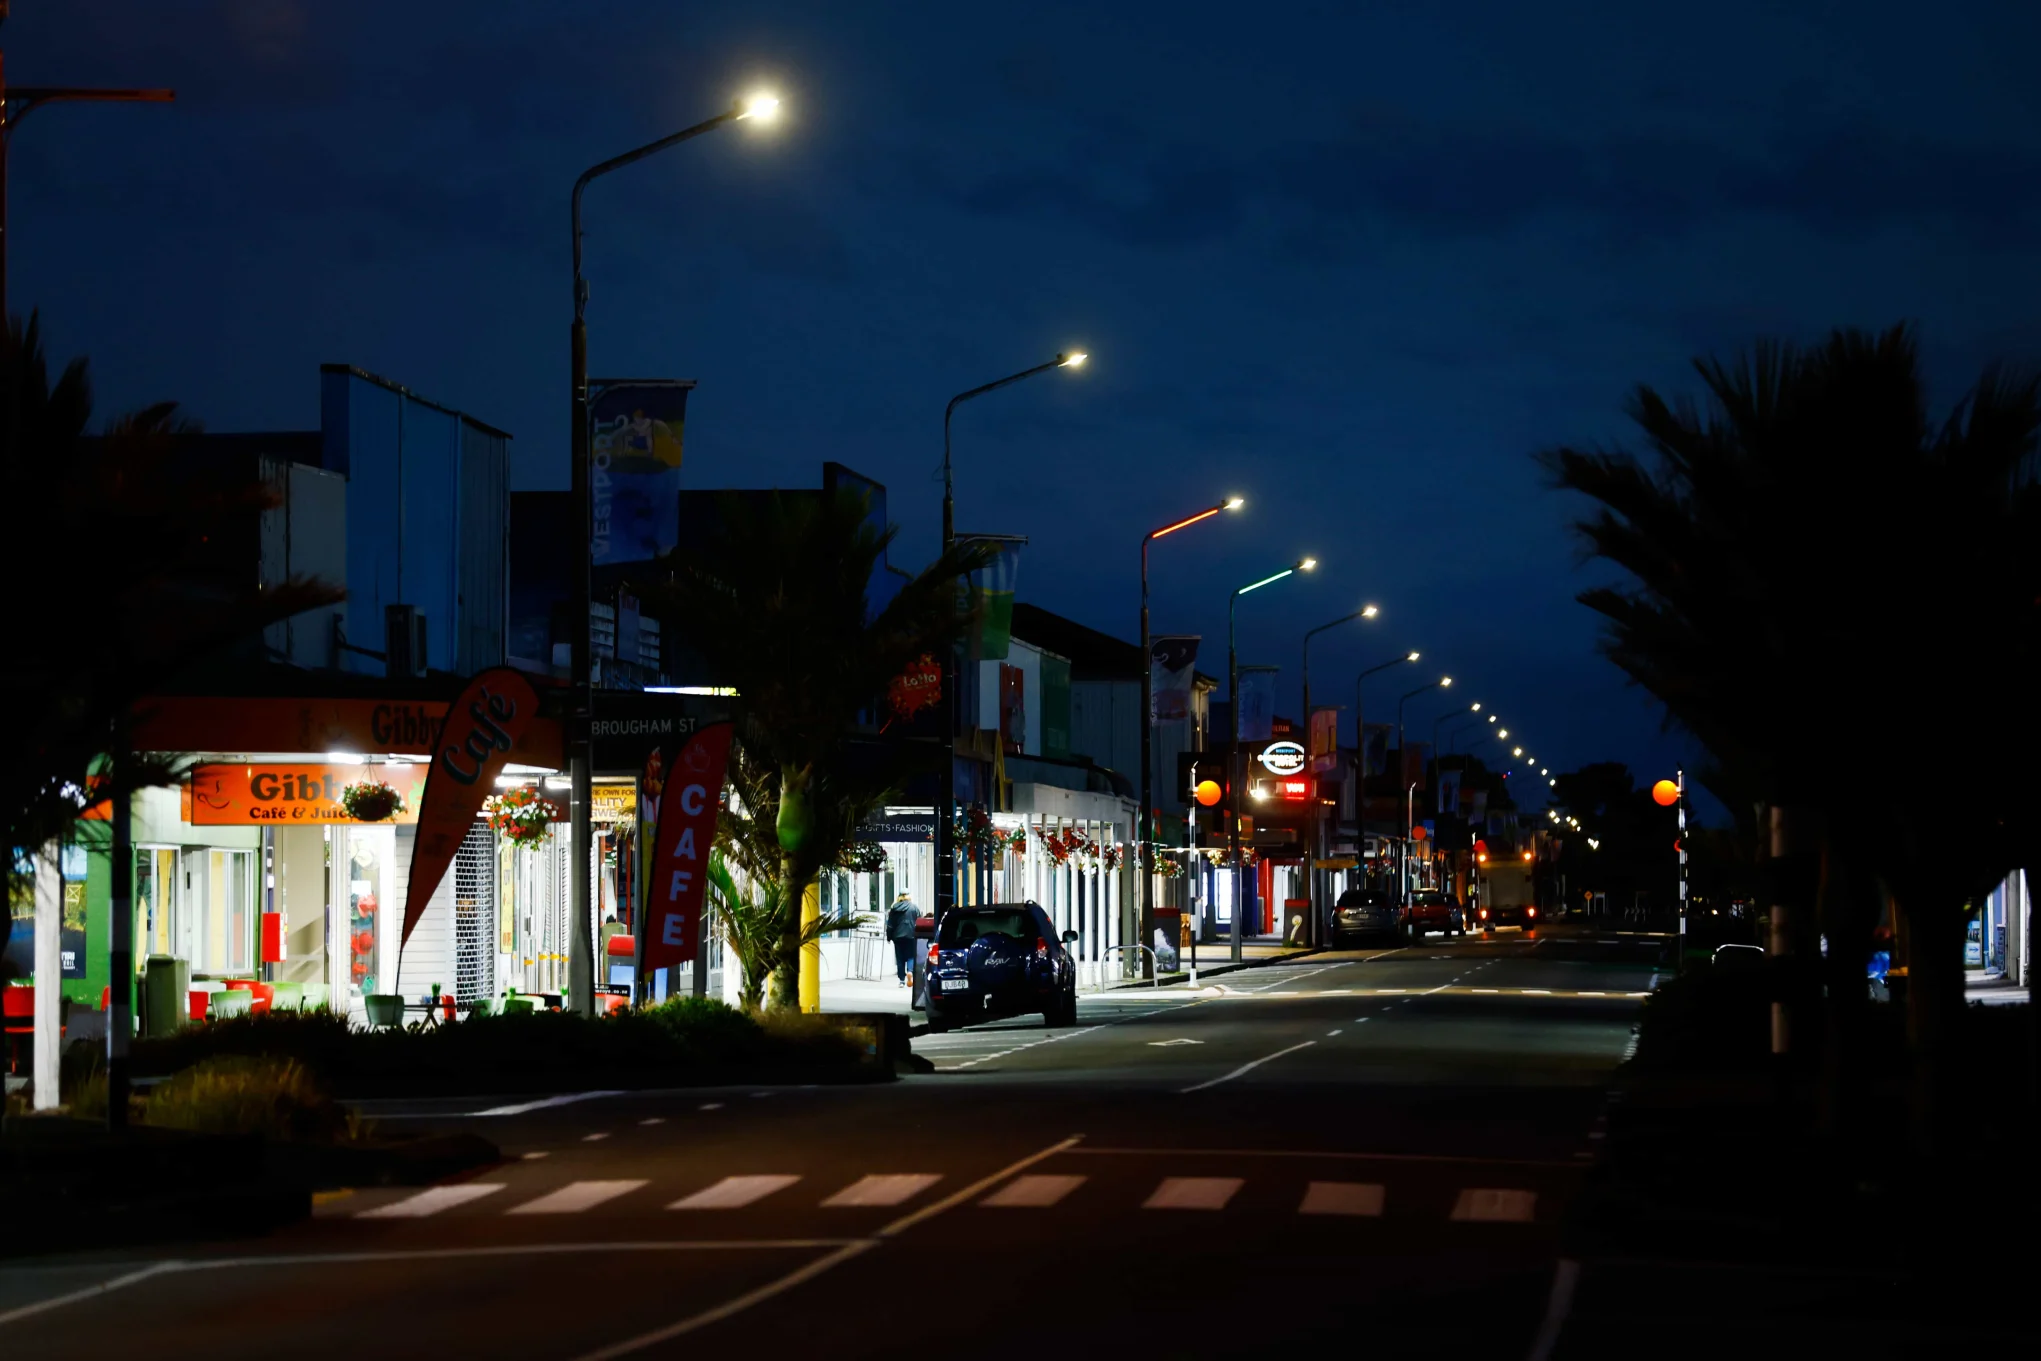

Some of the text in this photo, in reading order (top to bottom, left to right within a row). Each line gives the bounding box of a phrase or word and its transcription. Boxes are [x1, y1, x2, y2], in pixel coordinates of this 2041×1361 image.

[902, 673, 937, 687] Lotto
[591, 718, 696, 735] BROUGHAM ST
[442, 684, 517, 785] Café
[250, 806, 287, 819] Café
